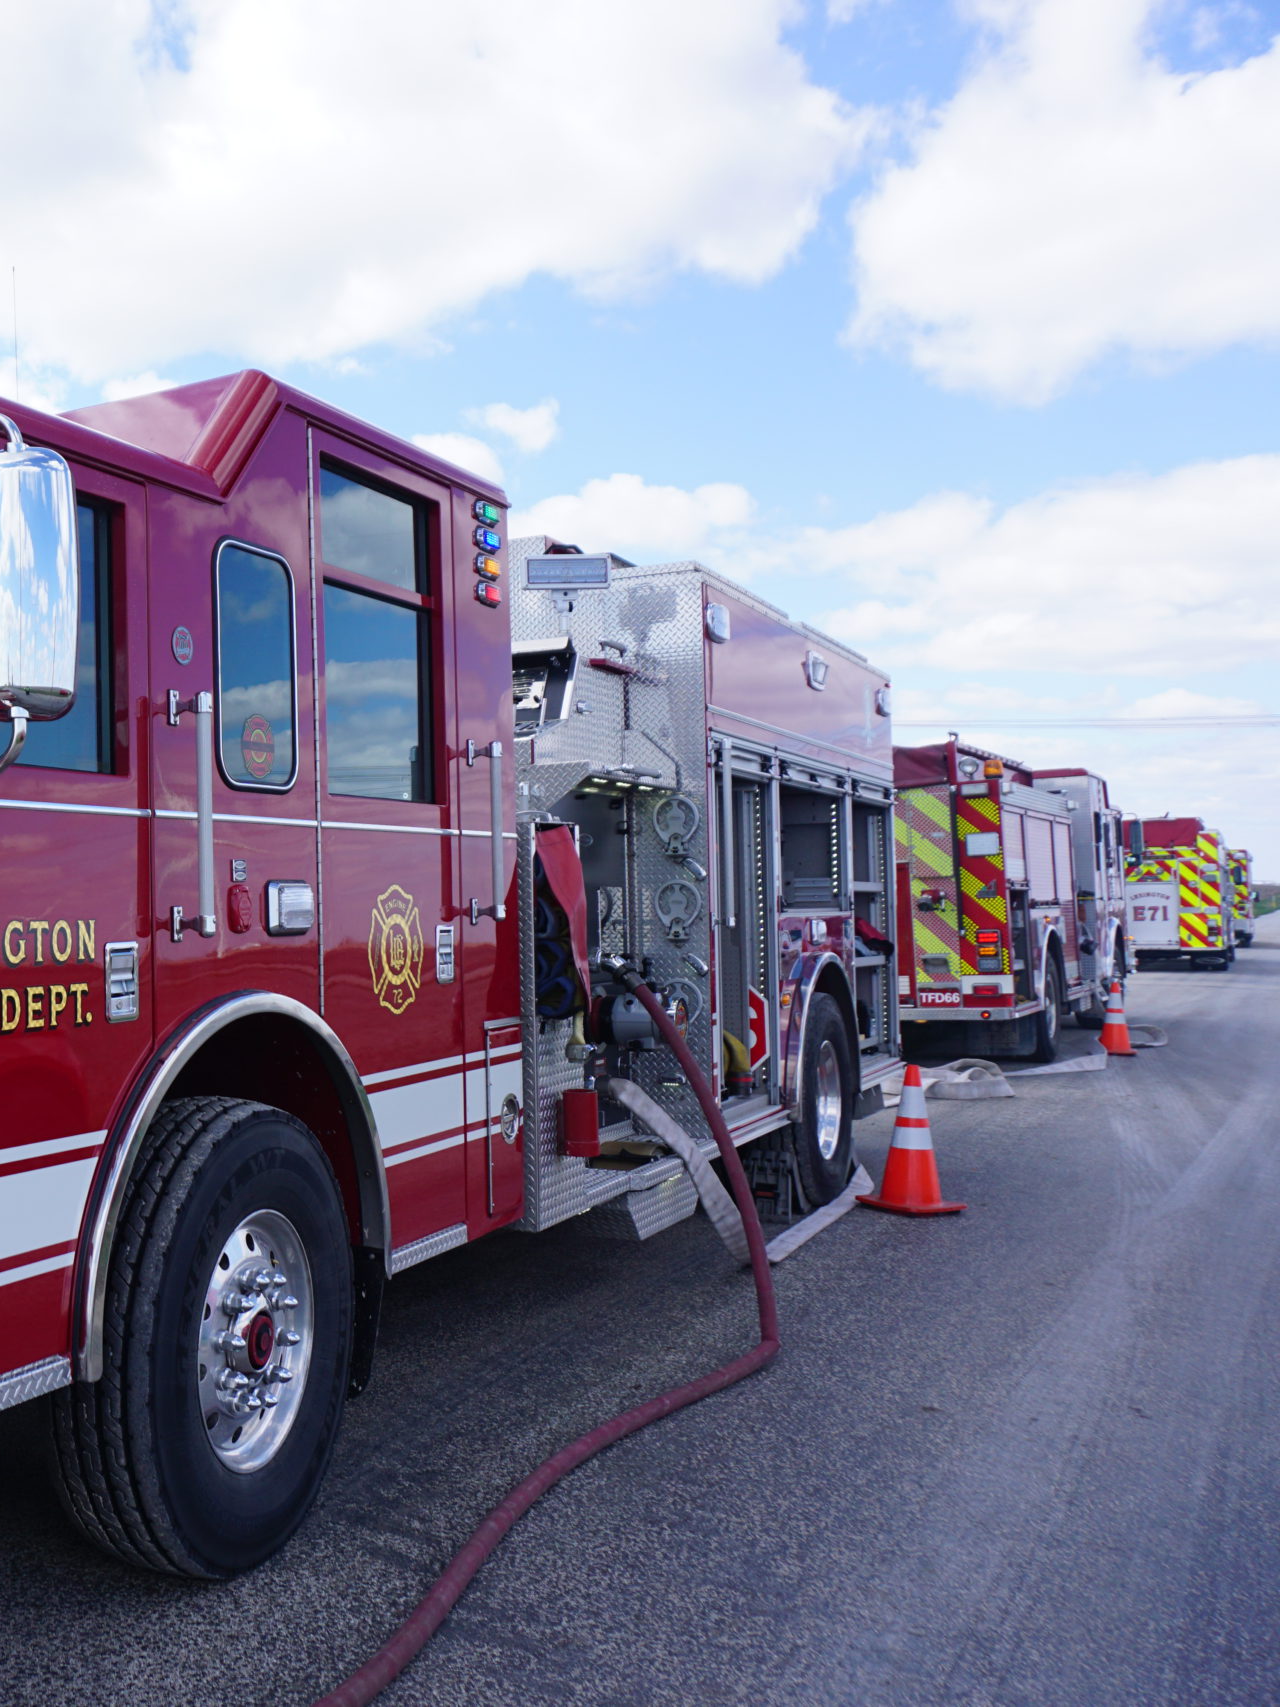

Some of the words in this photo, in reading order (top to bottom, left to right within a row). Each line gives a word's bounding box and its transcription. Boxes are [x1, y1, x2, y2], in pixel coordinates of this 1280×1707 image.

[384, 898, 407, 912] ENGINE
[1132, 905, 1170, 922] E71
[392, 988, 403, 1003] 72
[920, 992, 961, 1003] TFD66
